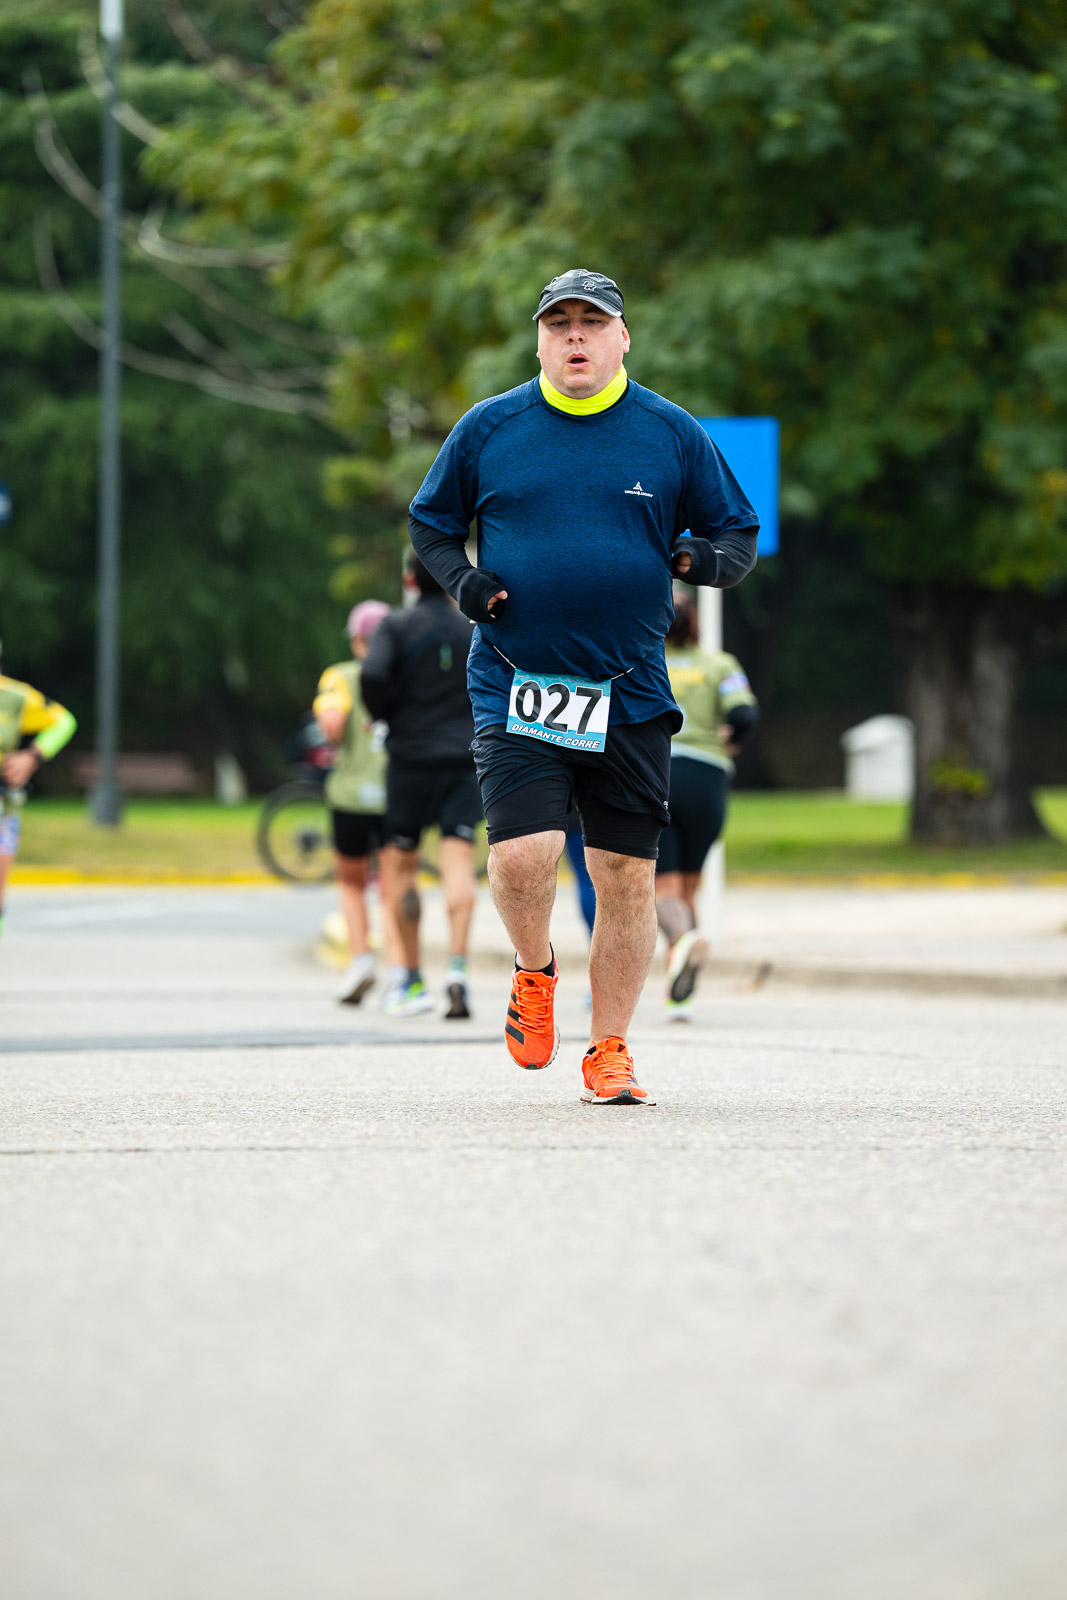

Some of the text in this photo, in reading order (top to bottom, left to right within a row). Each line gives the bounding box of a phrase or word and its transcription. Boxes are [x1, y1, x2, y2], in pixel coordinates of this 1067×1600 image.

[515, 680, 603, 735] 027
[511, 723, 600, 749] DIAMANTE CORRE
